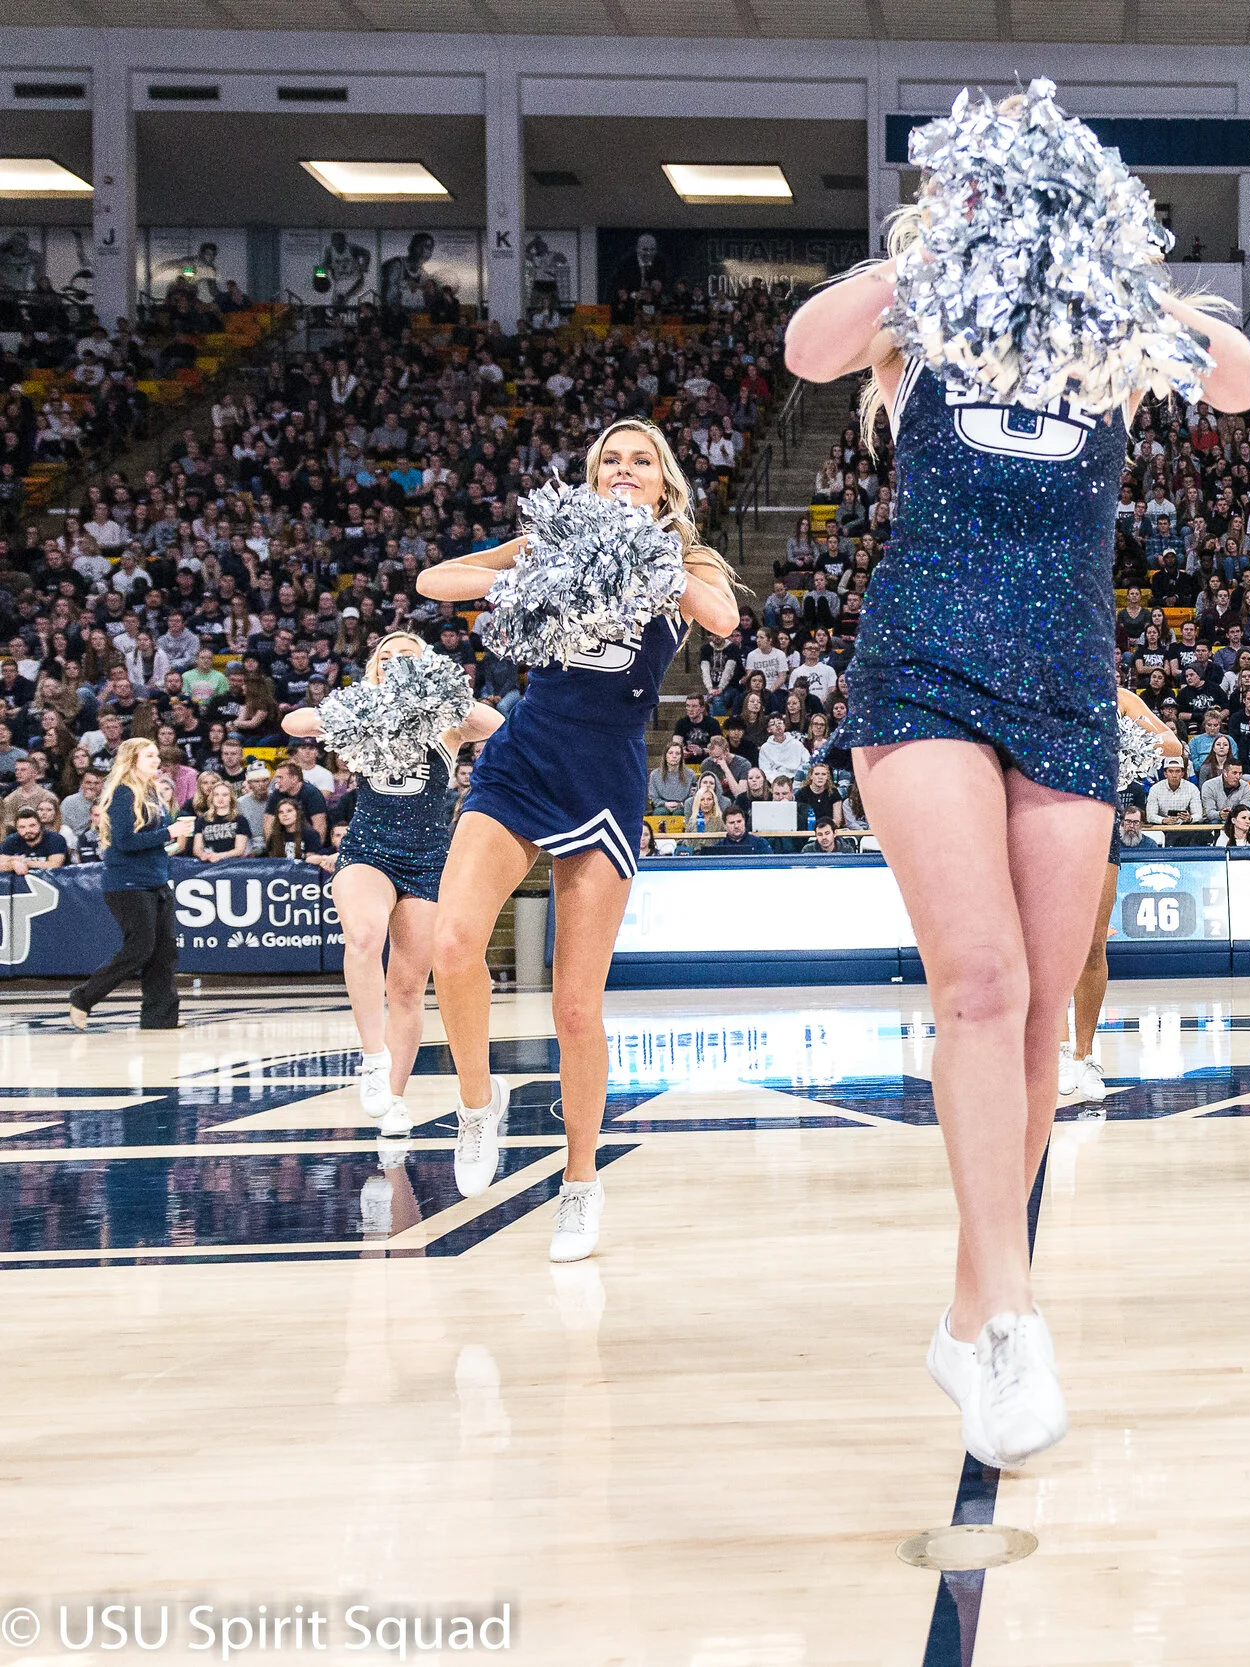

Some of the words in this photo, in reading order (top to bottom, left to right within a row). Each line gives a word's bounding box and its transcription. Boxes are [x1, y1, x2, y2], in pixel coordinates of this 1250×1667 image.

[103, 228, 115, 245] J
[496, 230, 511, 248] K
[167, 878, 263, 928] SU
[268, 903, 341, 927] Unio
[1137, 897, 1180, 932] 46
